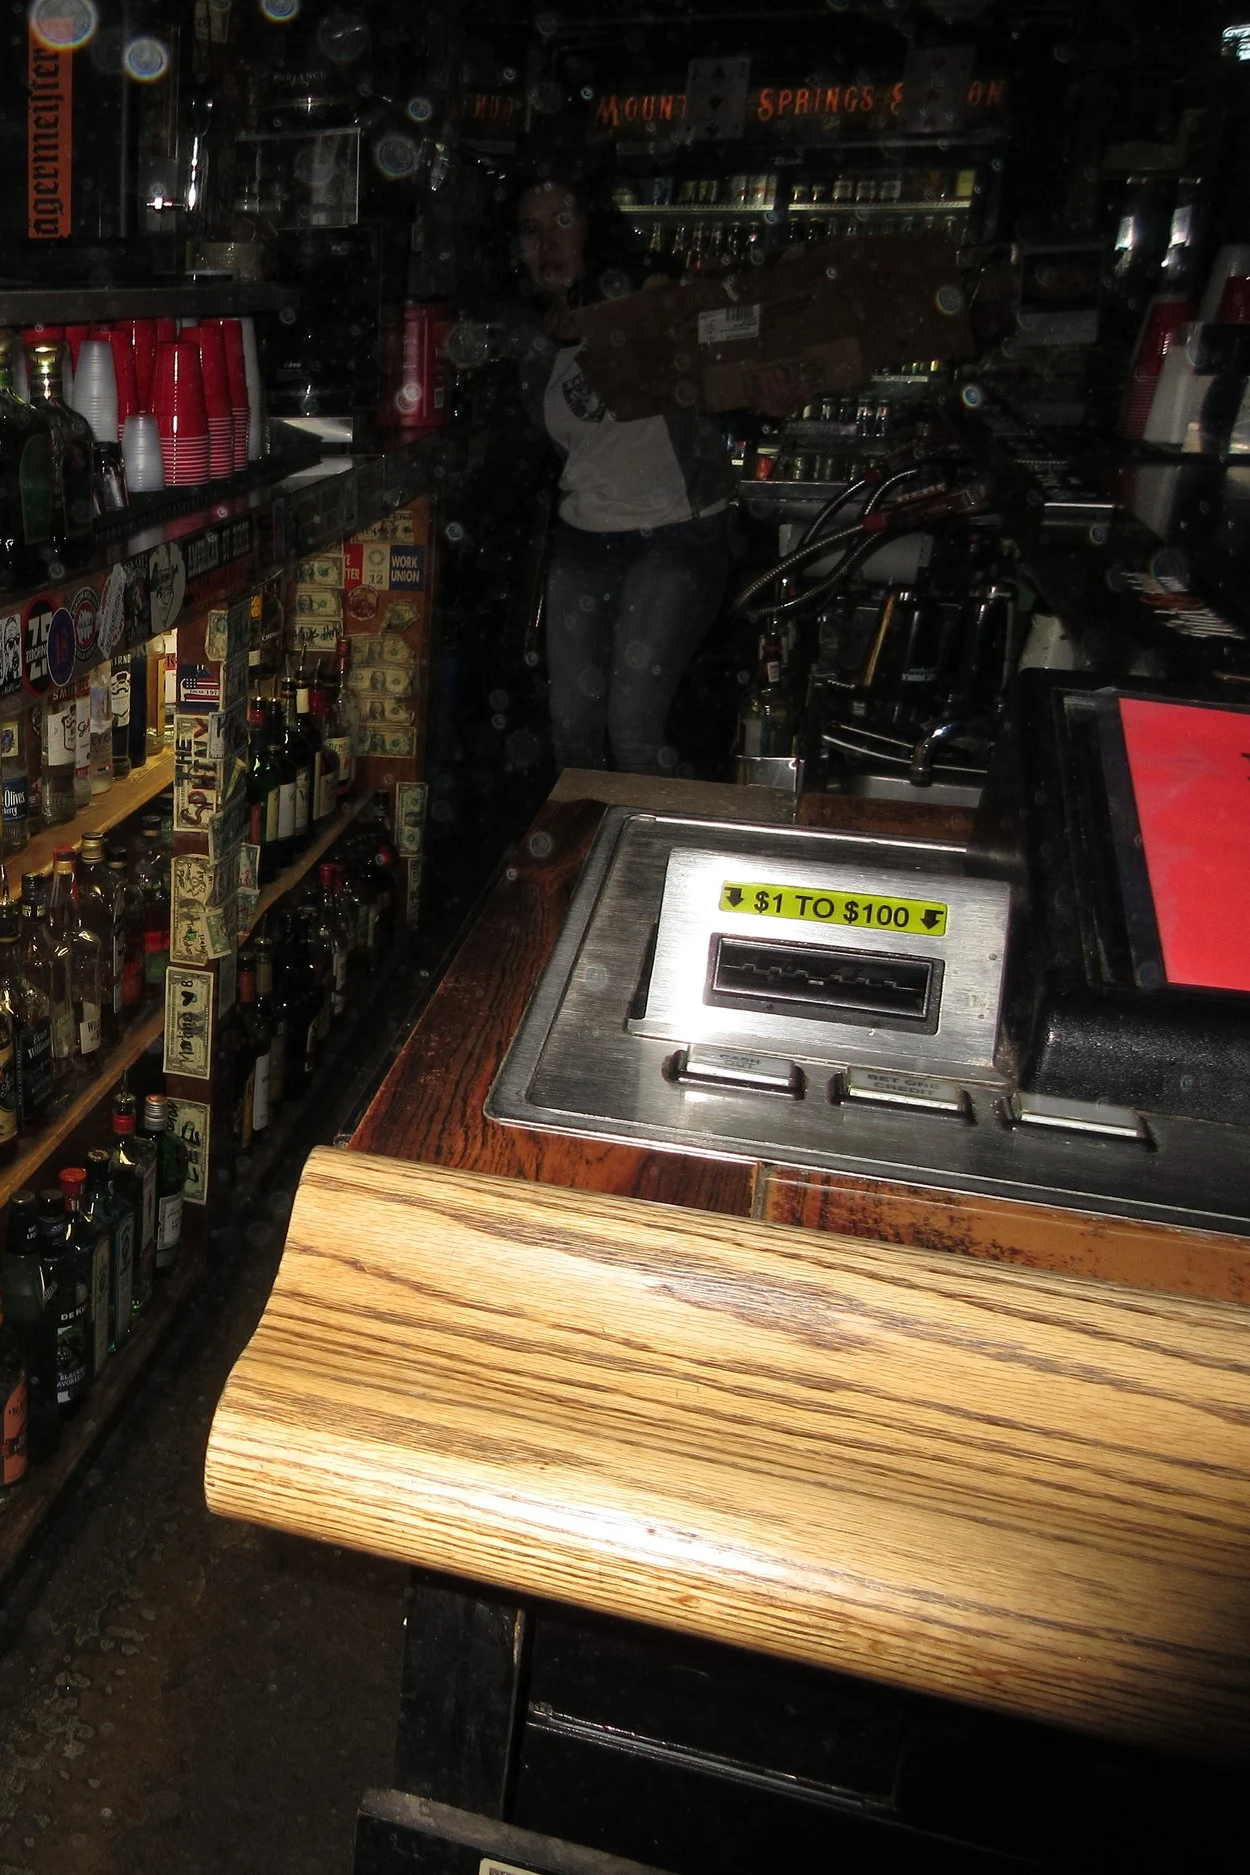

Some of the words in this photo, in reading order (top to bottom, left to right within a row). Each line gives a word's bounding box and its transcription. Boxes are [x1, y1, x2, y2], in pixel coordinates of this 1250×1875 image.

[756, 82, 875, 122] SPRINGS
[391, 554, 419, 568] WORK
[391, 569, 420, 584] UNION
[4, 789, 26, 808] Olives
[753, 889, 784, 914] $1
[795, 894, 835, 919] TO
[842, 899, 910, 928] $100
[867, 1073, 901, 1085] BET
[904, 1078, 940, 1091] ONE
[873, 1081, 938, 1097] CREDIT
